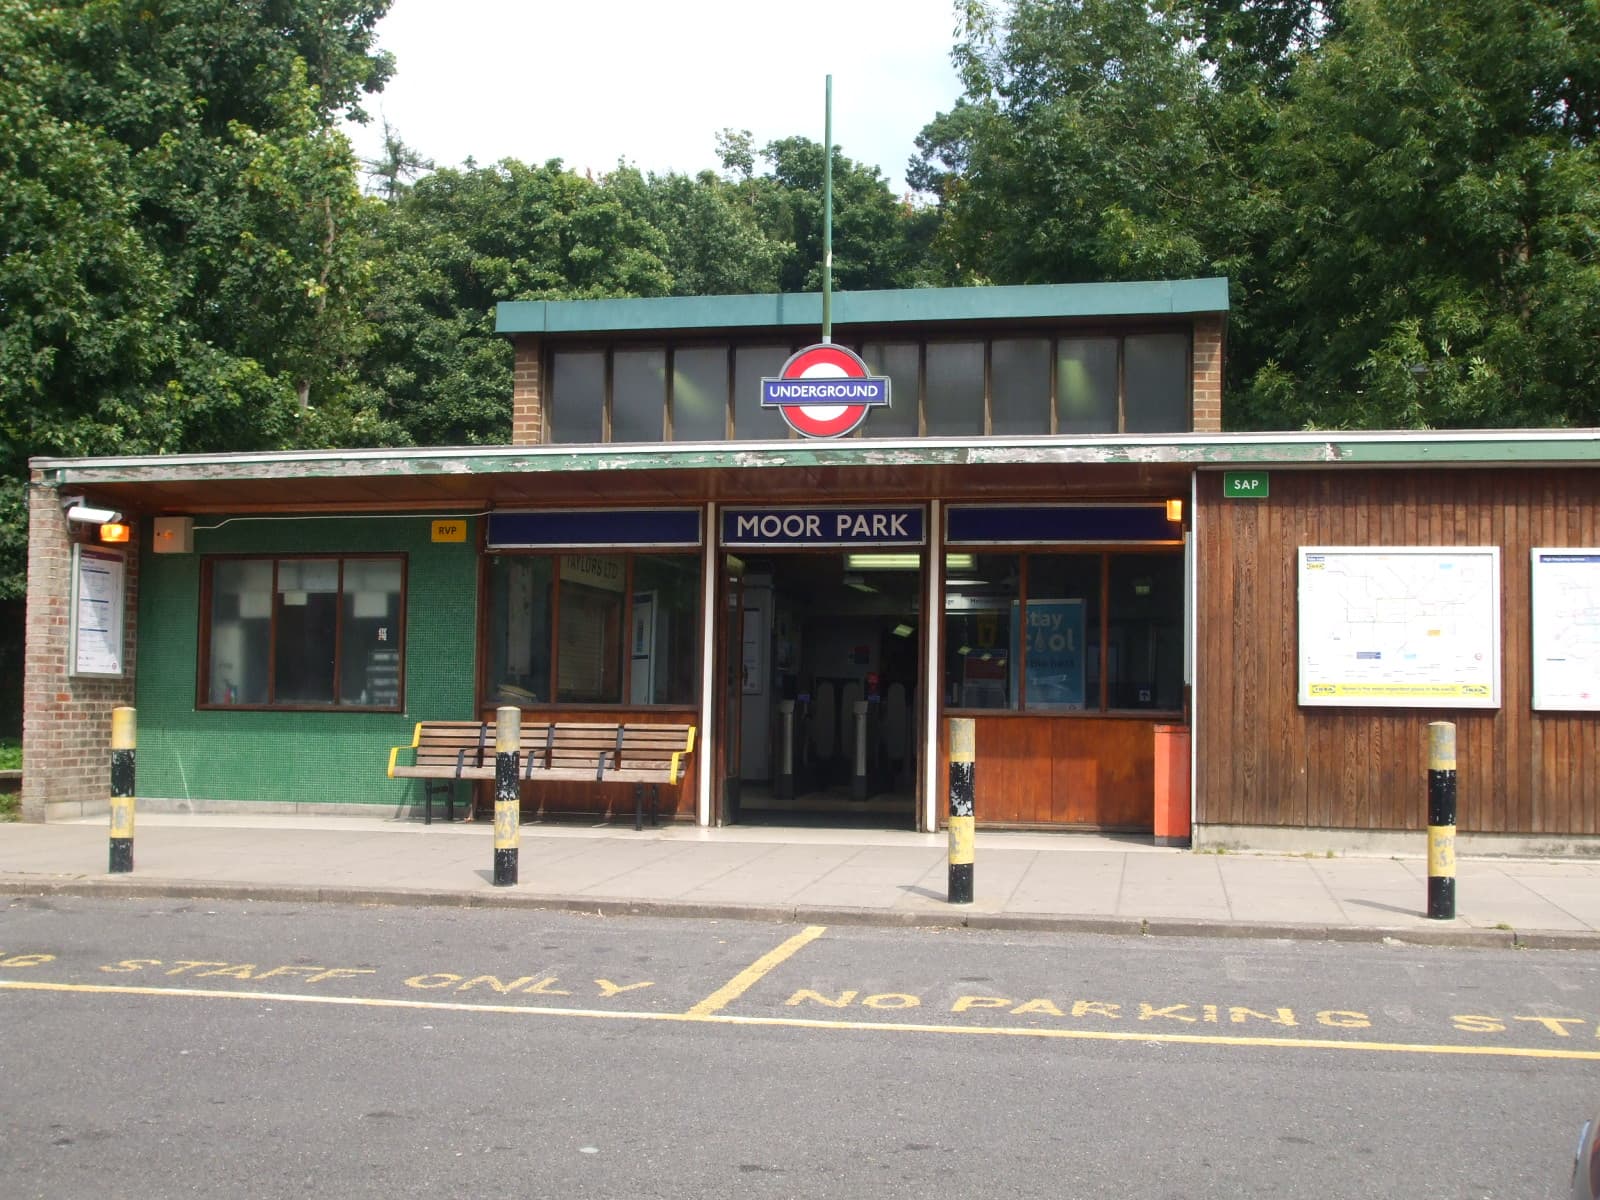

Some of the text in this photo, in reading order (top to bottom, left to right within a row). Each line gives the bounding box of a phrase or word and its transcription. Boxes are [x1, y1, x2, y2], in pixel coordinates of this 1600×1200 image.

[769, 385, 879, 397] UNDERGROUND
[1234, 479, 1259, 490] SAP
[438, 526, 457, 536] RVP
[737, 514, 909, 537] MOOR PARK
[99, 959, 376, 982] STAFF
[404, 973, 655, 998] ONLY
[784, 988, 1600, 1038] NO PARKING ST
